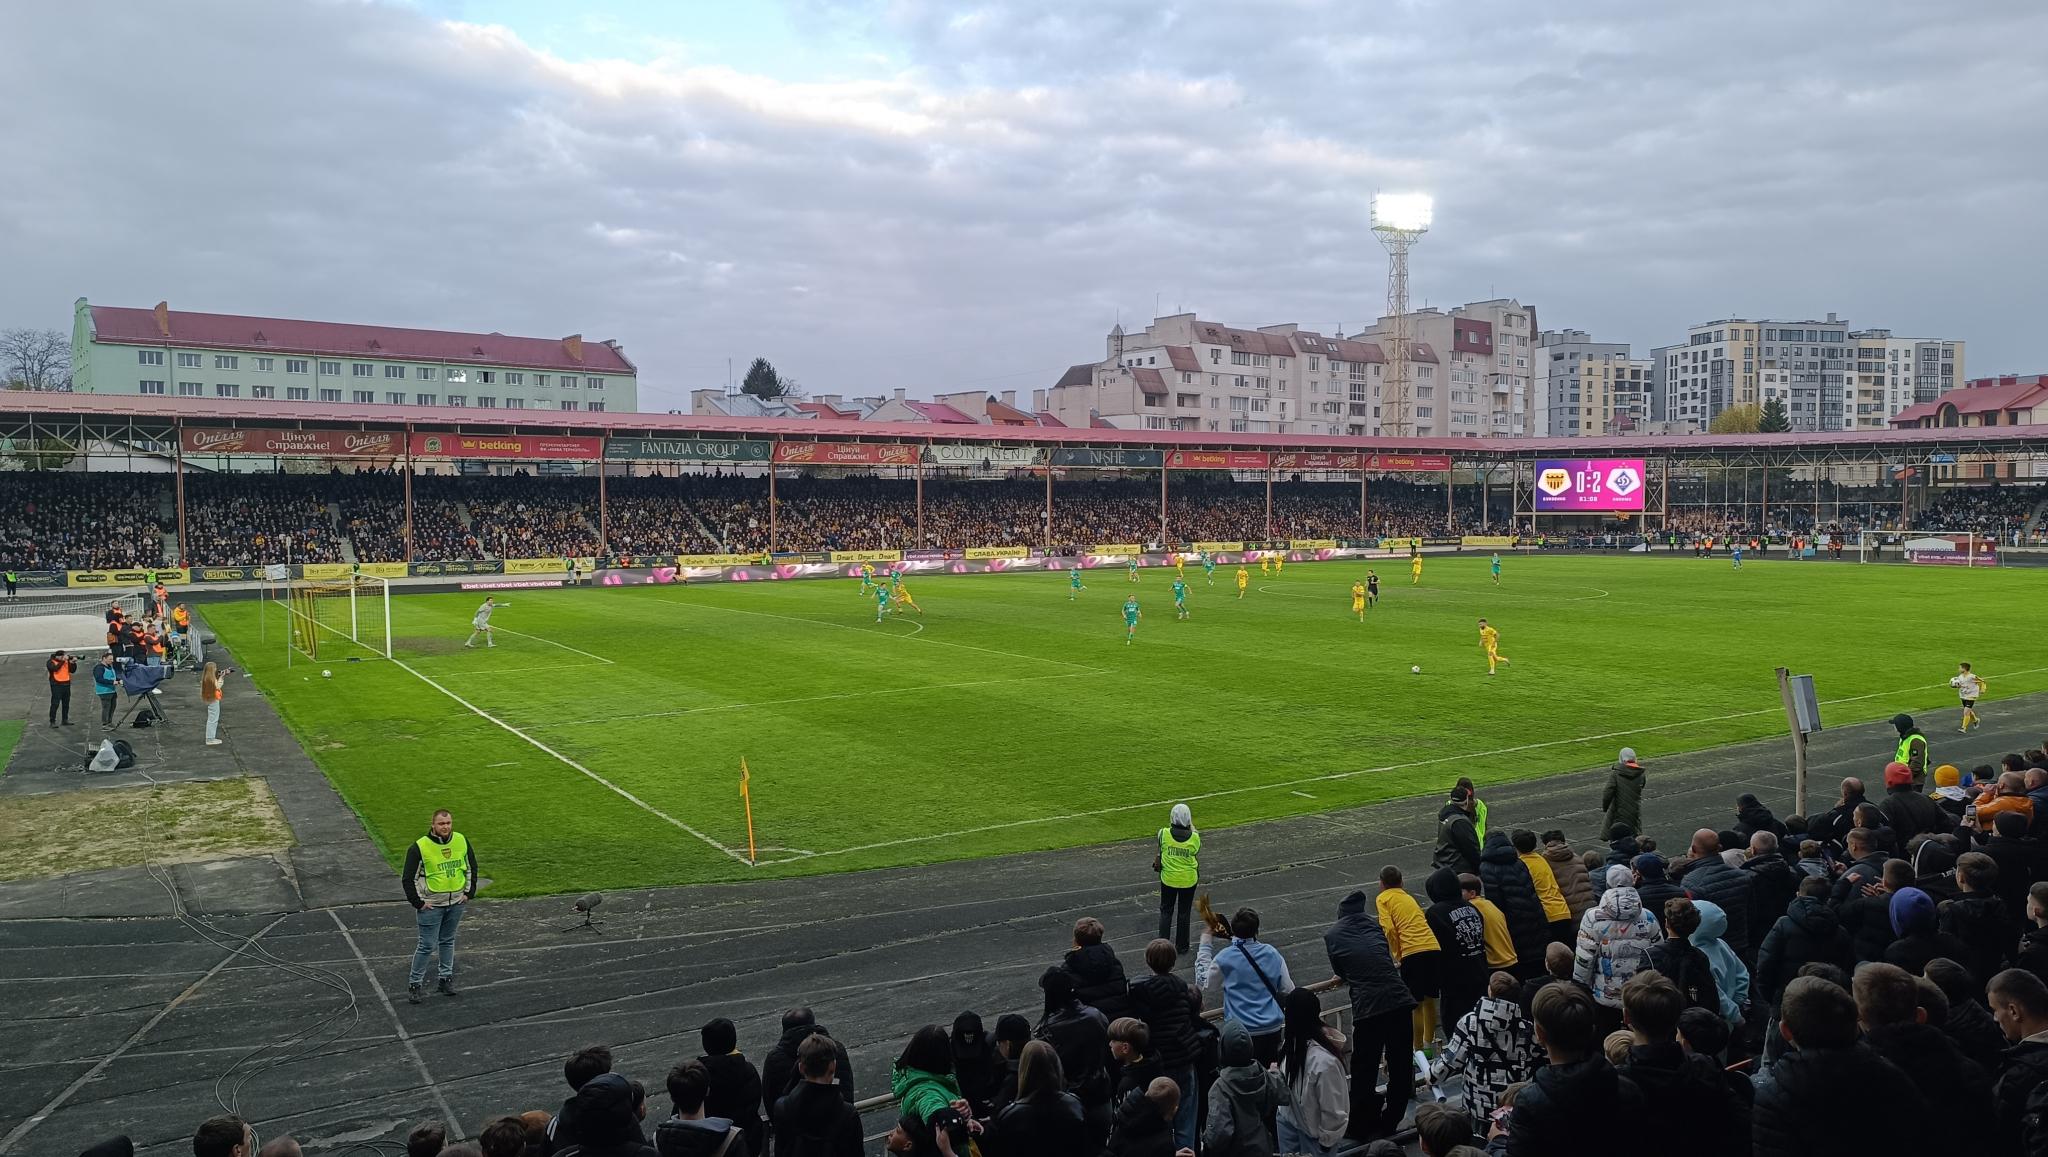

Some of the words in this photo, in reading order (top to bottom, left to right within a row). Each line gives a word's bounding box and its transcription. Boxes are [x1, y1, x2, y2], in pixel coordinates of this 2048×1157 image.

[193, 431, 245, 446] Опілля
[281, 432, 316, 443] Цінуй
[344, 434, 390, 449] Опілля
[479, 440, 521, 452] betking
[641, 441, 692, 455] FANTAZIA
[696, 443, 739, 458] GROUP
[941, 447, 1028, 459] CONTINENT
[1203, 455, 1226, 464] betking
[1576, 471, 1601, 493] 0:2
